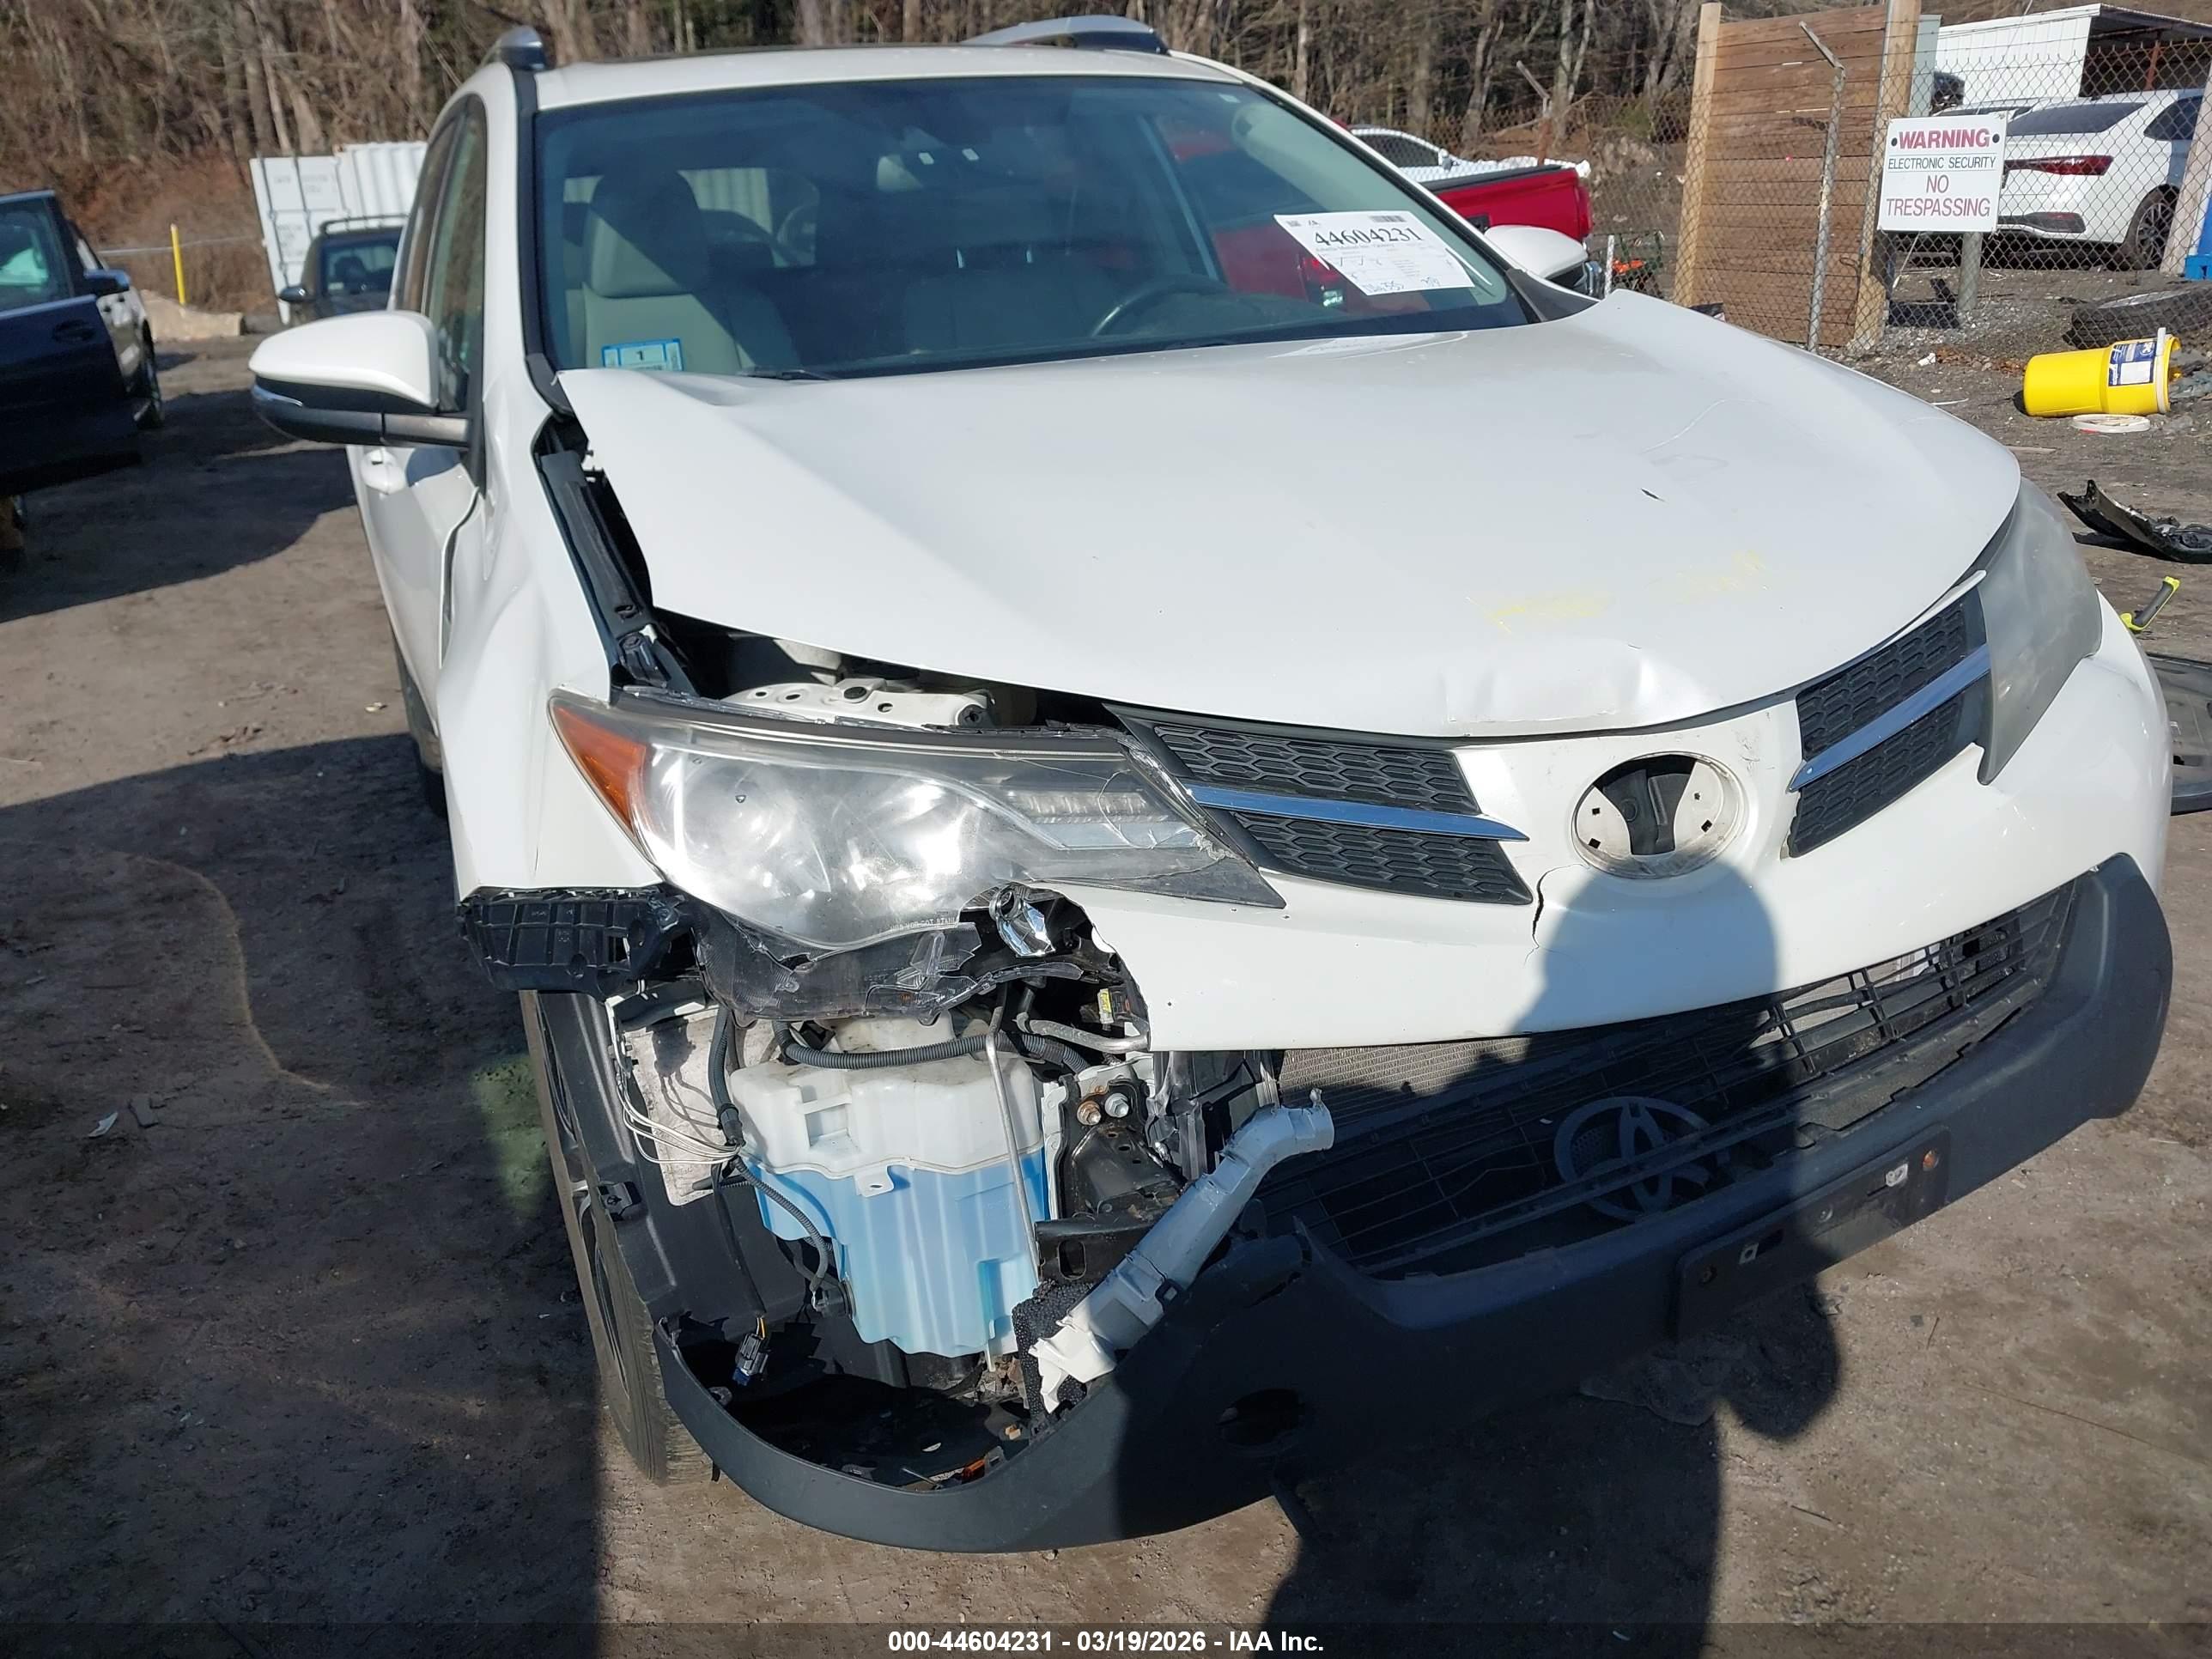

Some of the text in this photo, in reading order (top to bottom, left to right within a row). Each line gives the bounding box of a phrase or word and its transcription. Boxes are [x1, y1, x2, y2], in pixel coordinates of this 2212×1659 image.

[1899, 128, 1990, 149] WARNING
[1888, 156, 1996, 170] ELECTRONIC SECURITY
[1926, 174, 1949, 193] NO
[1887, 198, 1990, 216] TRESPASSING
[1315, 227, 1423, 246] 44604231
